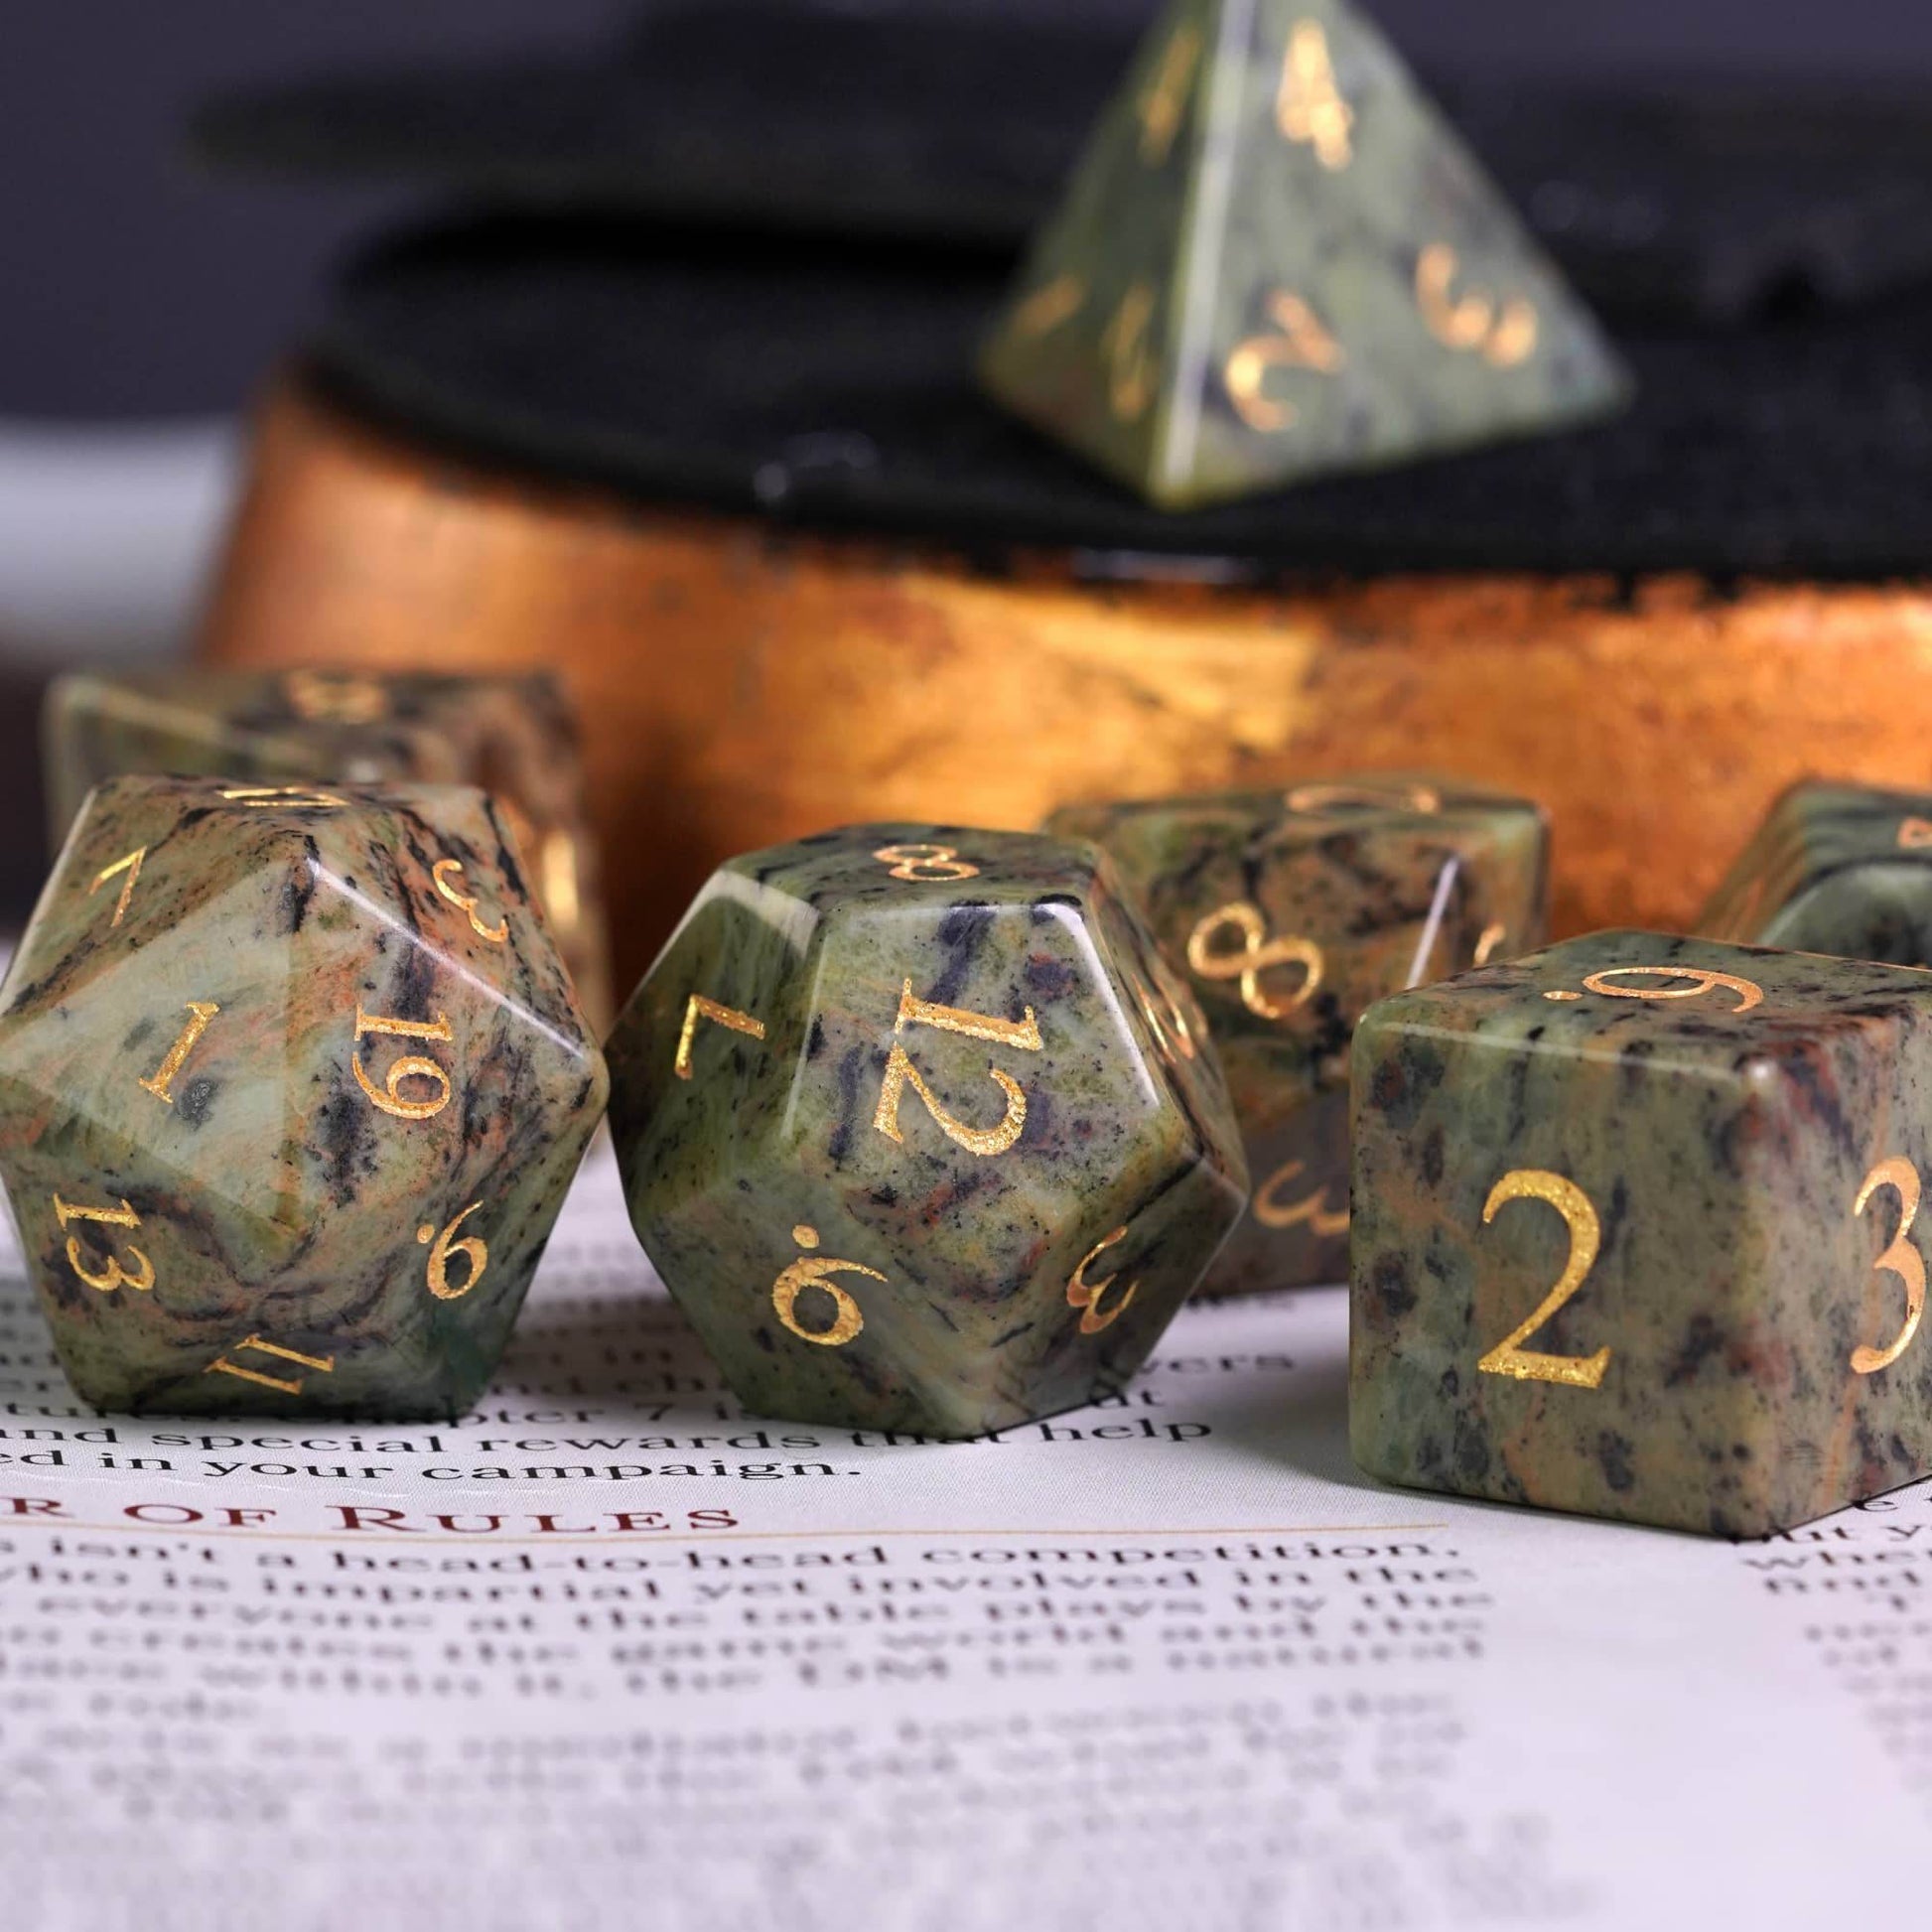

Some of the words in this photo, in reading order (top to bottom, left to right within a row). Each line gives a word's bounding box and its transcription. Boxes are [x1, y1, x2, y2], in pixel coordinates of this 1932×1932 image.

[433, 859, 508, 942] 3
[875, 844, 979, 881] 8
[1188, 901, 1322, 1020] 8
[139, 1001, 220, 1104] 1
[351, 1003, 455, 1121] 19
[675, 994, 765, 1080] 7
[874, 978, 1044, 1156] 12
[53, 1193, 156, 1292] 13
[1477, 1169, 1612, 1388] 2
[1850, 1157, 1927, 1374] 3
[97, 1451, 179, 1471] in
[201, 1460, 394, 1479] your
[420, 1459, 863, 1481] campaign.
[150, 1433, 449, 1453] special
[477, 1430, 823, 1453] rewards
[1038, 1419, 1212, 1444] help
[50, 1535, 215, 1564] isn't
[257, 1552, 299, 1570] a
[333, 1545, 889, 1573] head-to-head
[921, 1542, 1461, 1566] competition,
[123, 1502, 278, 1527] OF
[262, 1575, 660, 1603] impartial
[849, 1570, 1201, 1594] involved
[1343, 1565, 1480, 1587] the
